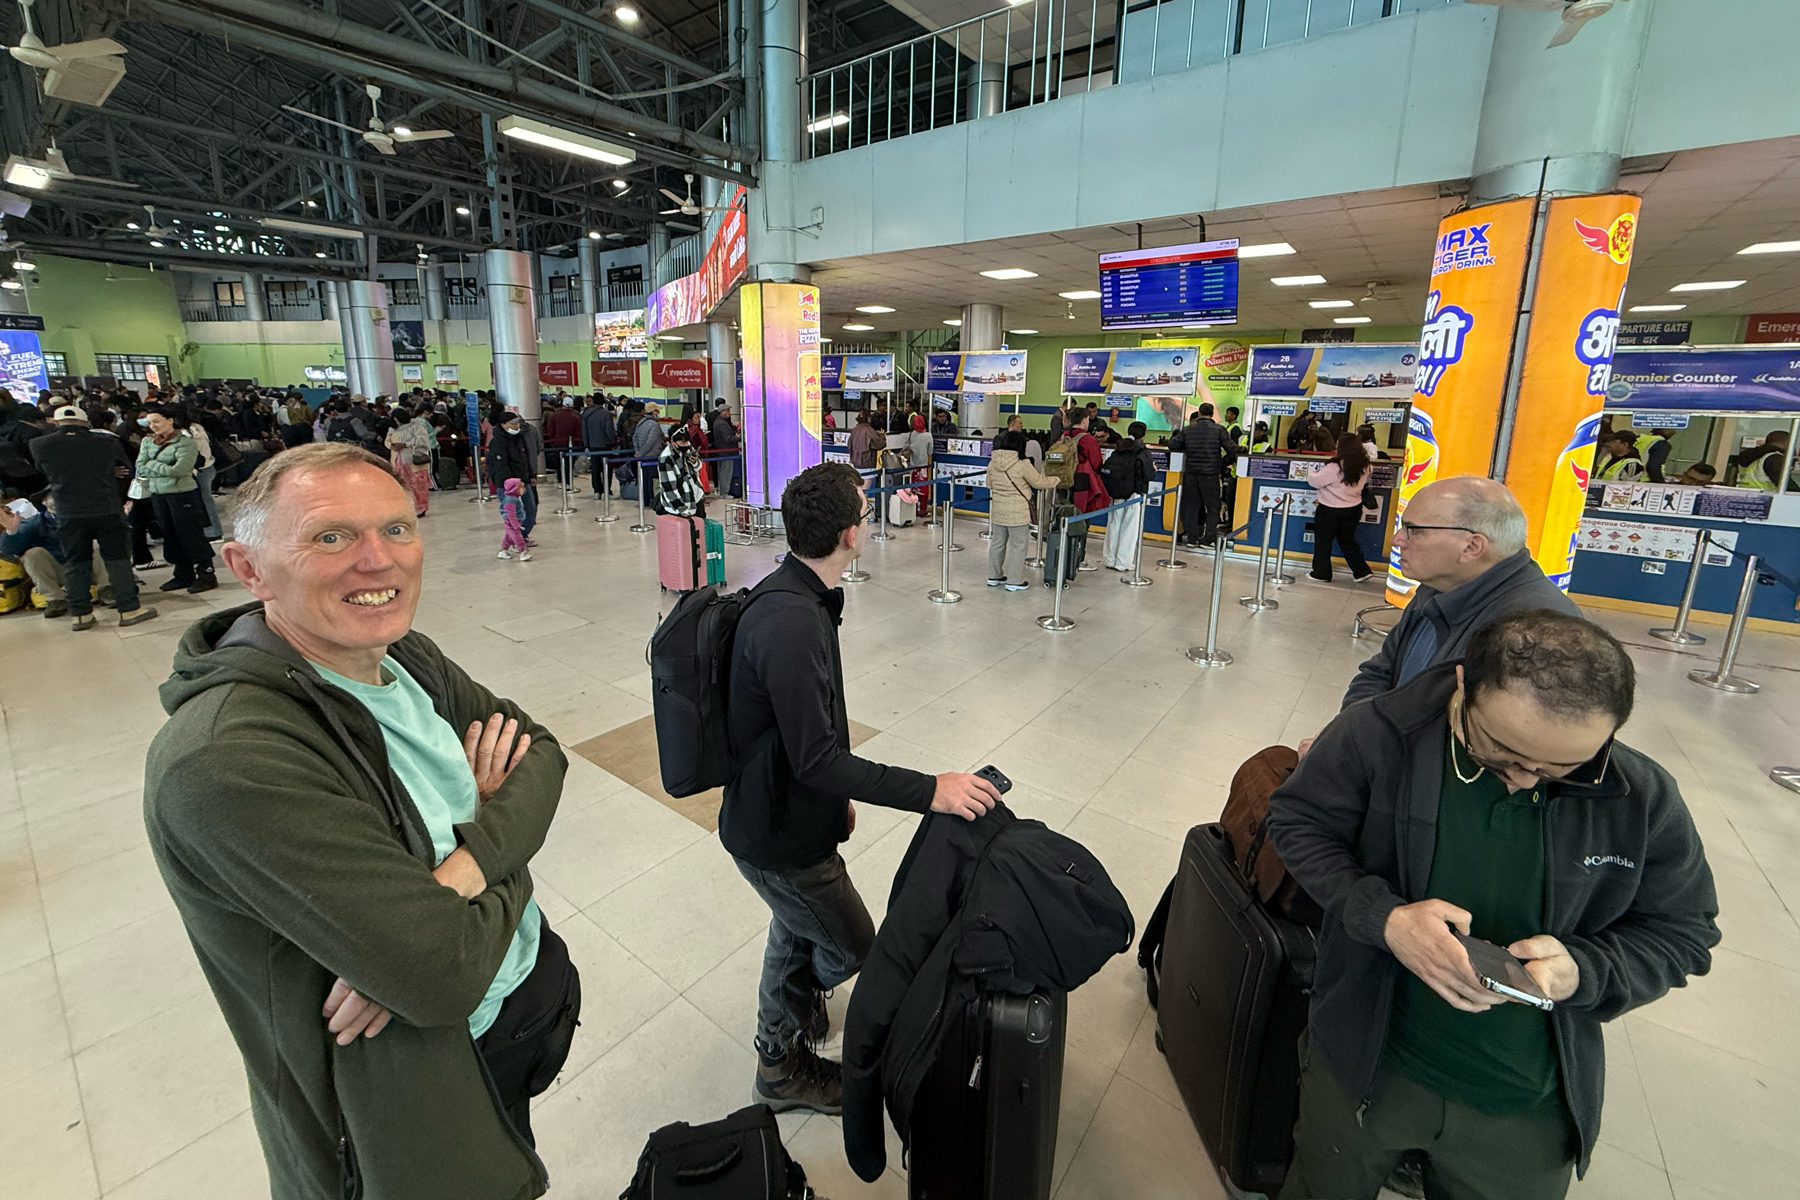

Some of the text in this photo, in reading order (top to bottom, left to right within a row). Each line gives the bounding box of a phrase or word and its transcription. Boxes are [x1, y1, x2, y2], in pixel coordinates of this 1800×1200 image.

[1436, 223, 1492, 254] MAX
[1432, 256, 1495, 275] NERGY DRINK
[1619, 323, 1688, 334] EPARTURE GATE
[11, 351, 37, 361] FUEL
[1207, 355, 1233, 366] Nimbu
[1280, 355, 1291, 363] 2B
[1402, 354, 1414, 364] 2A
[1254, 370, 1284, 379] Connecting
[1613, 373, 1739, 384] Premier Counter
[1582, 519, 1618, 532] angerous
[1619, 523, 1646, 534] Goods
